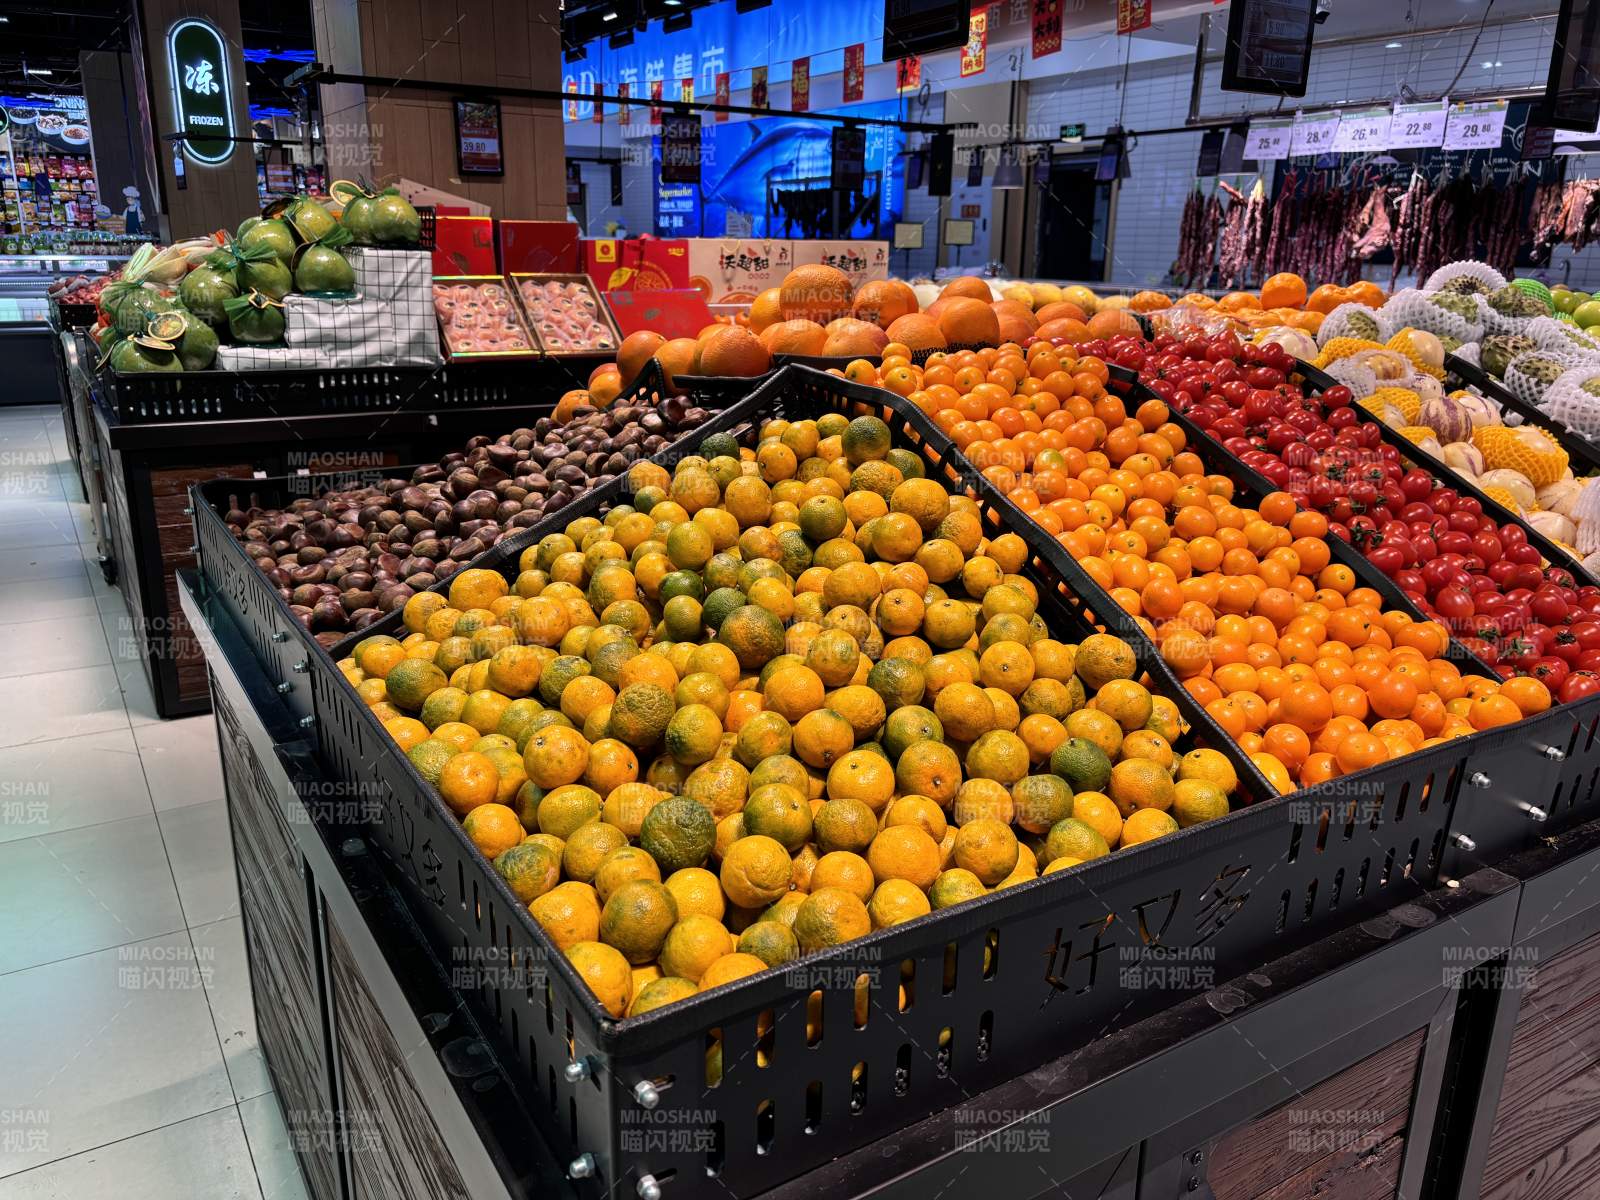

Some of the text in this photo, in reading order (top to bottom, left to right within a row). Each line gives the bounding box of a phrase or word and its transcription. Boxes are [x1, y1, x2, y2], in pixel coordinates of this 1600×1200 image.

[178, 58, 220, 95] 冻
[189, 115, 224, 126] FROZEN
[1405, 122, 1433, 136] 22.80
[1462, 123, 1492, 138] 29.80
[463, 141, 486, 153] 39.80
[1040, 864, 1253, 1013] 好又多
